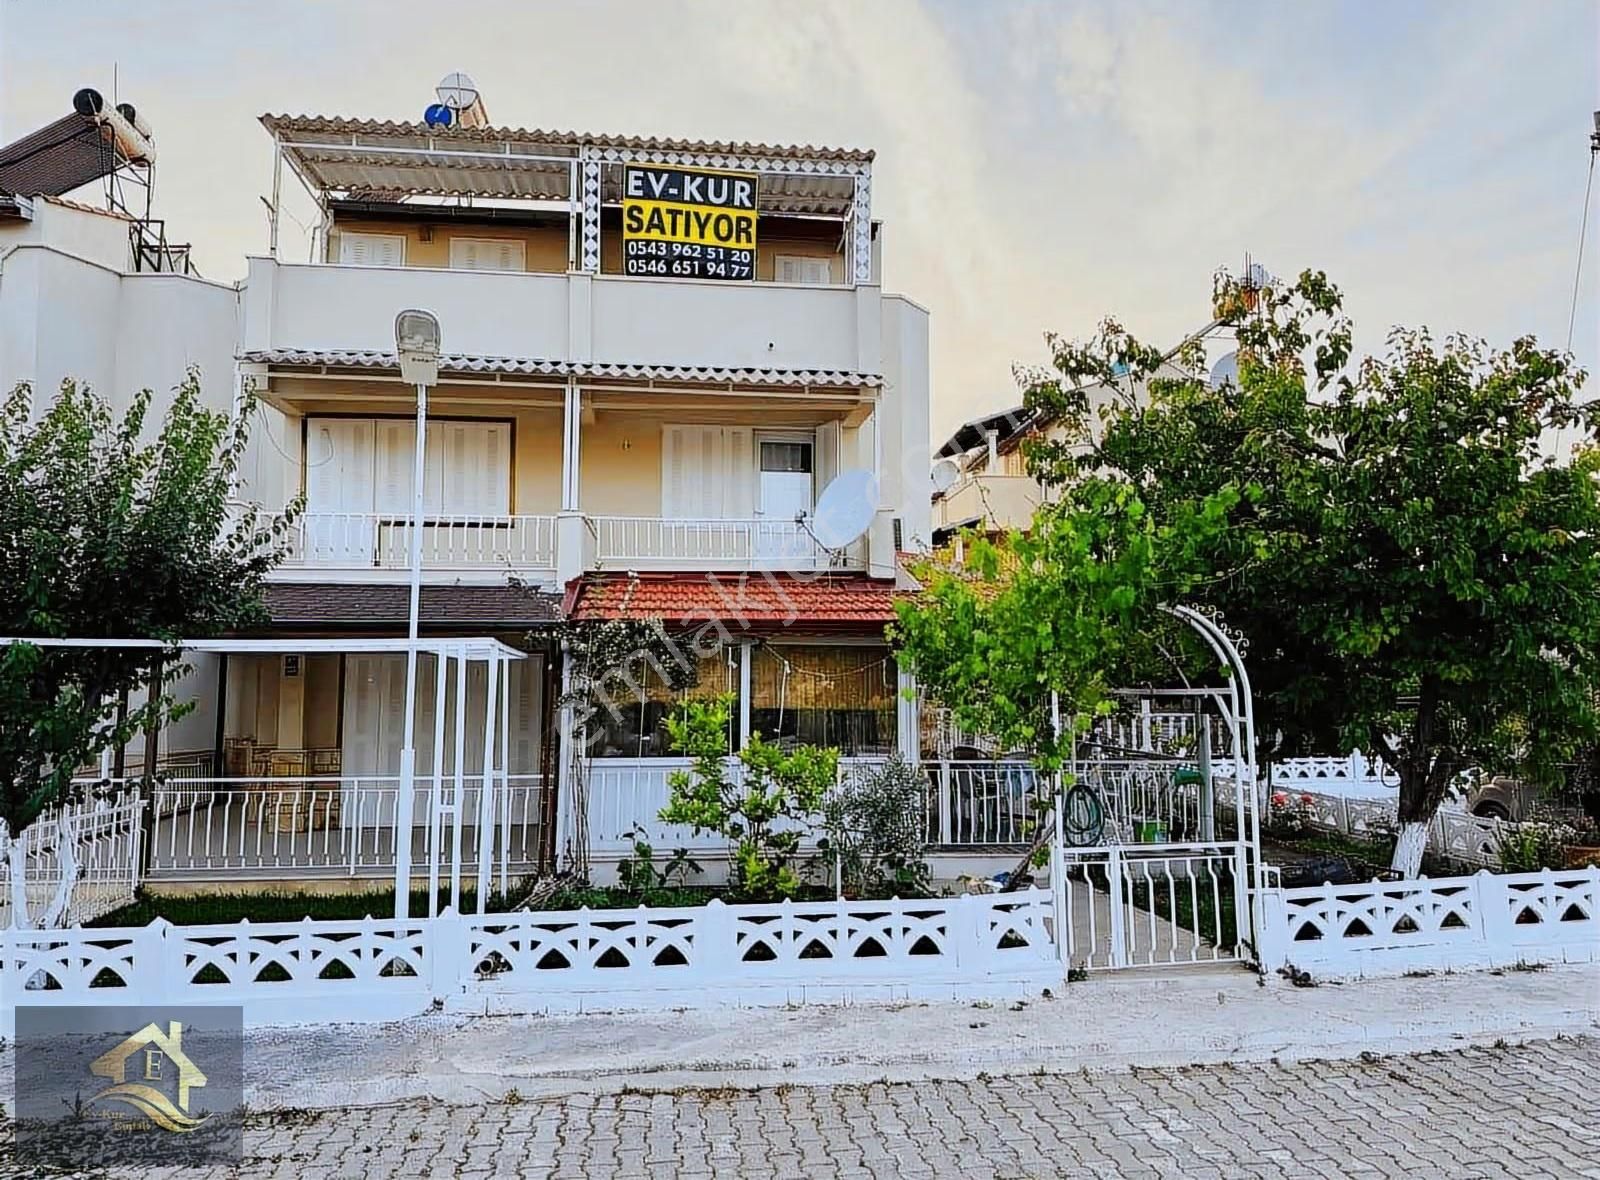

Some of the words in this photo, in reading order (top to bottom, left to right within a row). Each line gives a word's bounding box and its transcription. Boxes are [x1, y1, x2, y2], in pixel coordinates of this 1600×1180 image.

[628, 170, 752, 206] EV-KUR
[626, 205, 753, 244] SATIYOR
[628, 241, 667, 256] 0543
[672, 243, 702, 258] 962
[706, 247, 725, 260] 51
[730, 250, 751, 264] 20
[628, 259, 667, 274] 0546
[672, 260, 699, 275] 651
[706, 263, 726, 277] 94
[730, 264, 750, 278] 77
